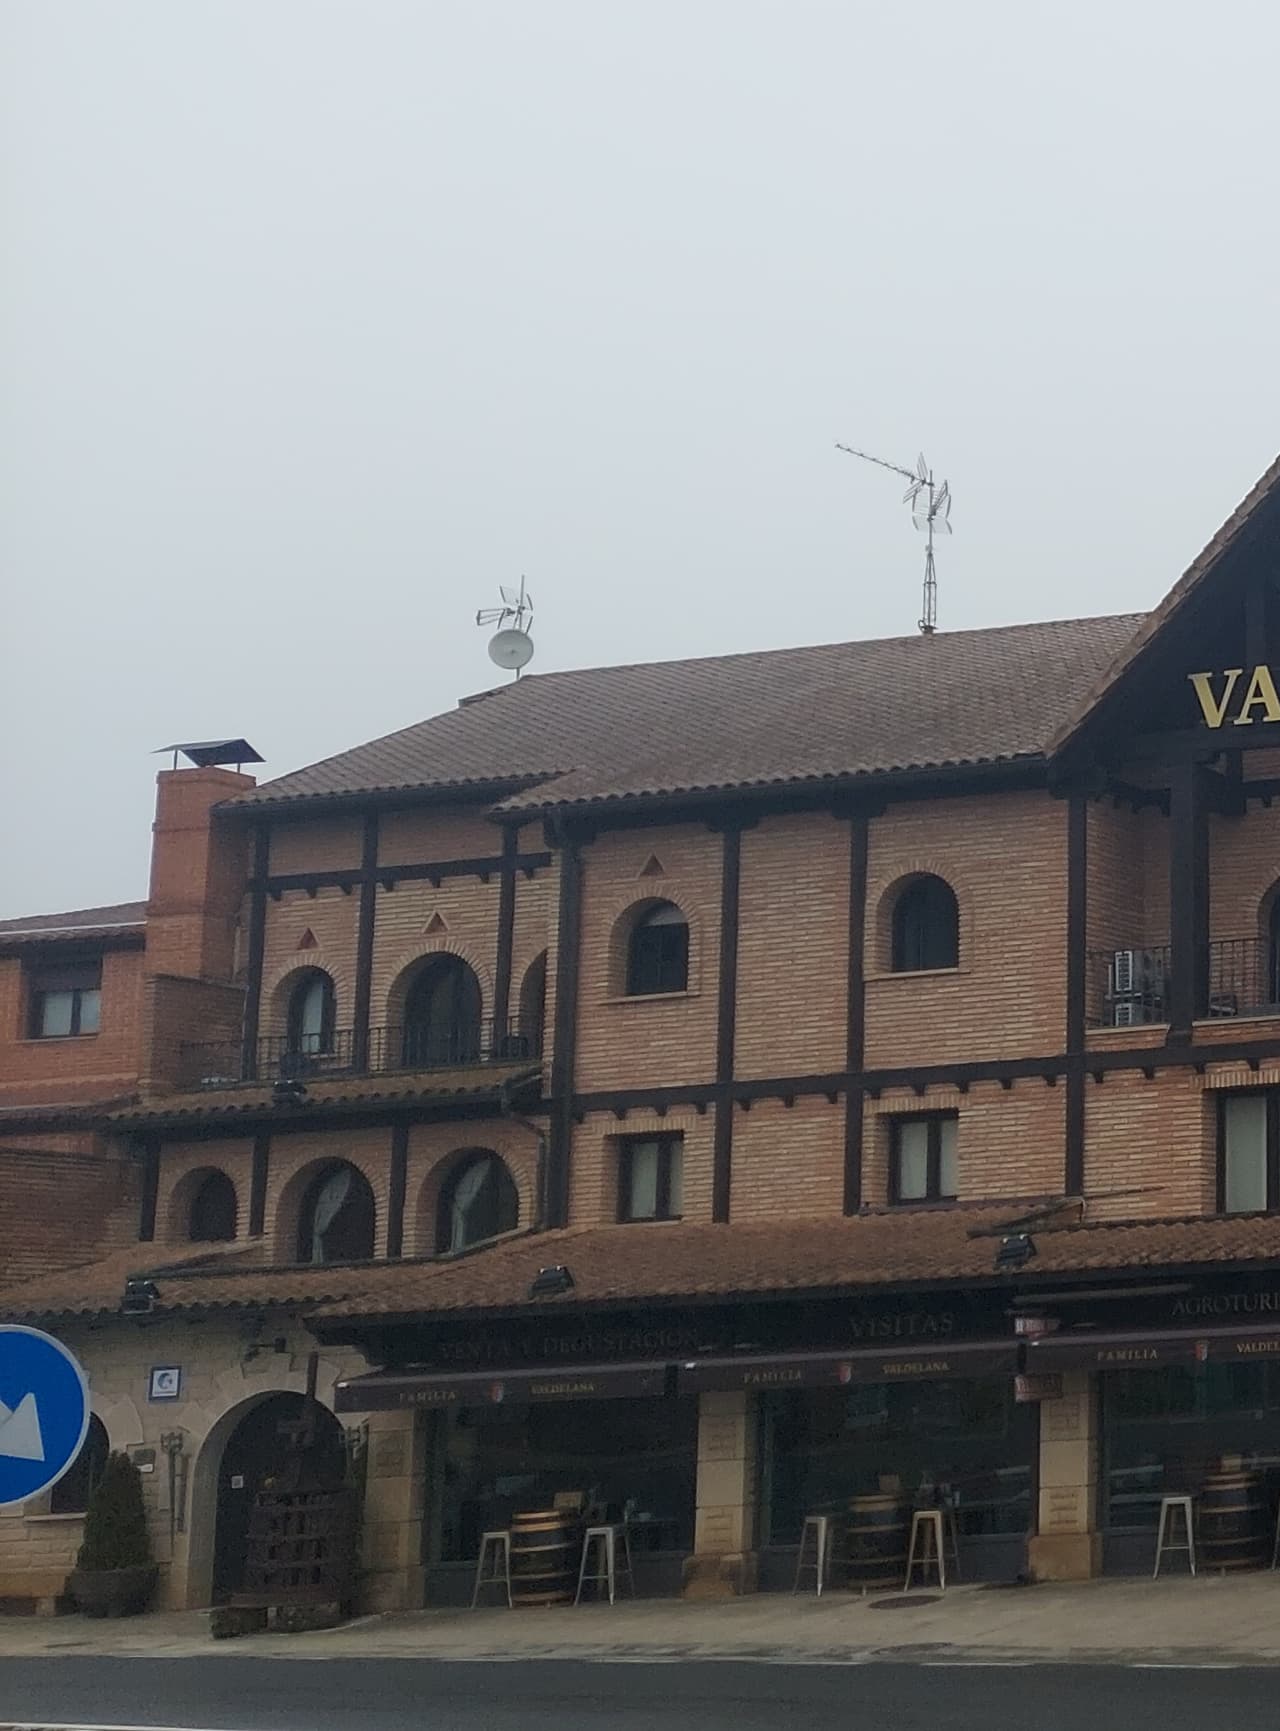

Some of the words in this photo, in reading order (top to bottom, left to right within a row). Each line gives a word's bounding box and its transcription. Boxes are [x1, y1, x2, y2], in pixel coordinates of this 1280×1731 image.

[850, 1312, 954, 1338] VISITAS
[1097, 1348, 1158, 1361] FAMILIA
[744, 1370, 802, 1384] FAMILIA
[399, 1390, 457, 1402] FAMILIA
